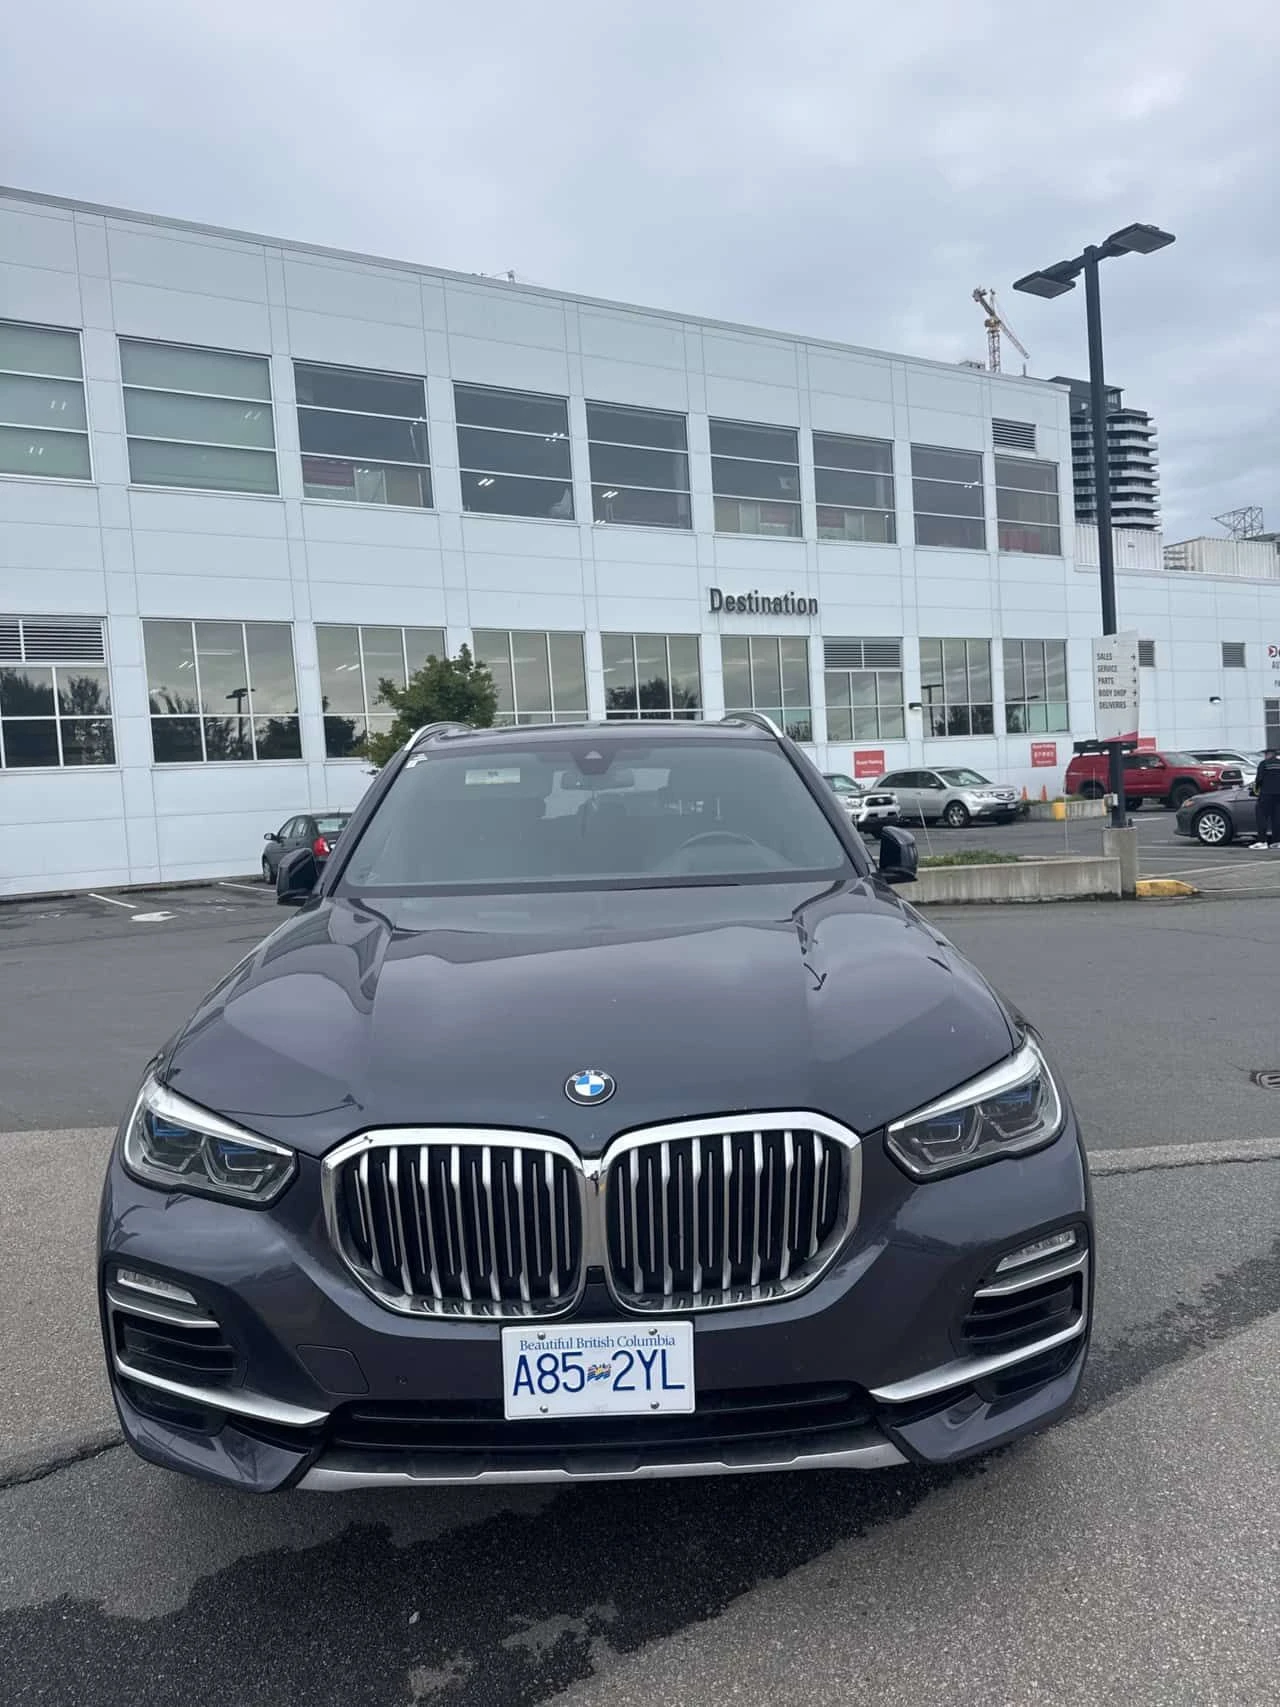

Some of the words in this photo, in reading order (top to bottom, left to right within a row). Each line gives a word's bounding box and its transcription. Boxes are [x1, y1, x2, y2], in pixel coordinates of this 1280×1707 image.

[709, 587, 818, 616] Destination
[1096, 652, 1112, 661] SALES
[1097, 664, 1117, 673] SERVICE
[1098, 677, 1114, 685] PARTS
[1099, 689, 1112, 697] BODY
[1113, 688, 1127, 697] SHOP
[520, 1337, 573, 1351] Beautiful
[576, 1336, 615, 1349] British
[617, 1334, 676, 1347] Columbia
[512, 1351, 586, 1396] A85
[611, 1349, 685, 1392] 2YL
